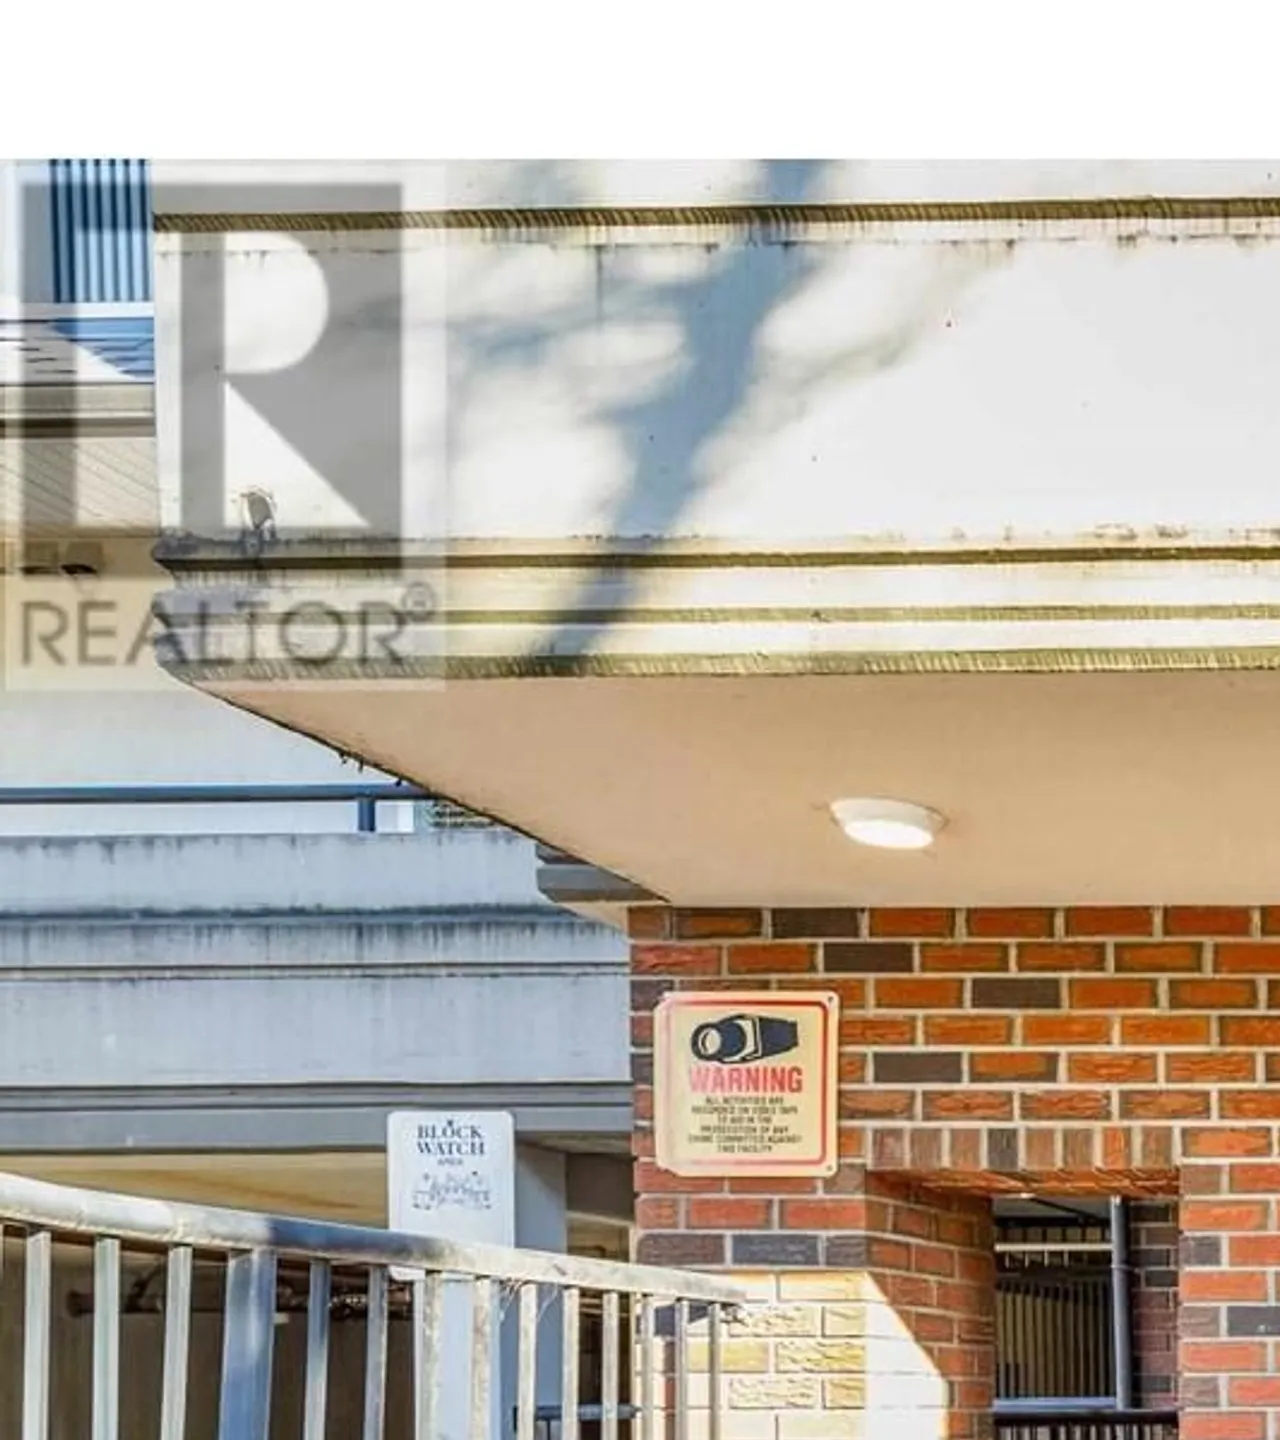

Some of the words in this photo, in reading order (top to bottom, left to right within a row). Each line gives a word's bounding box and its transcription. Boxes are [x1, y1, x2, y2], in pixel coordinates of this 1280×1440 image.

[688, 1064, 803, 1094] WARNING
[417, 1124, 485, 1139] BLOCK
[416, 1141, 485, 1156] WATCH
